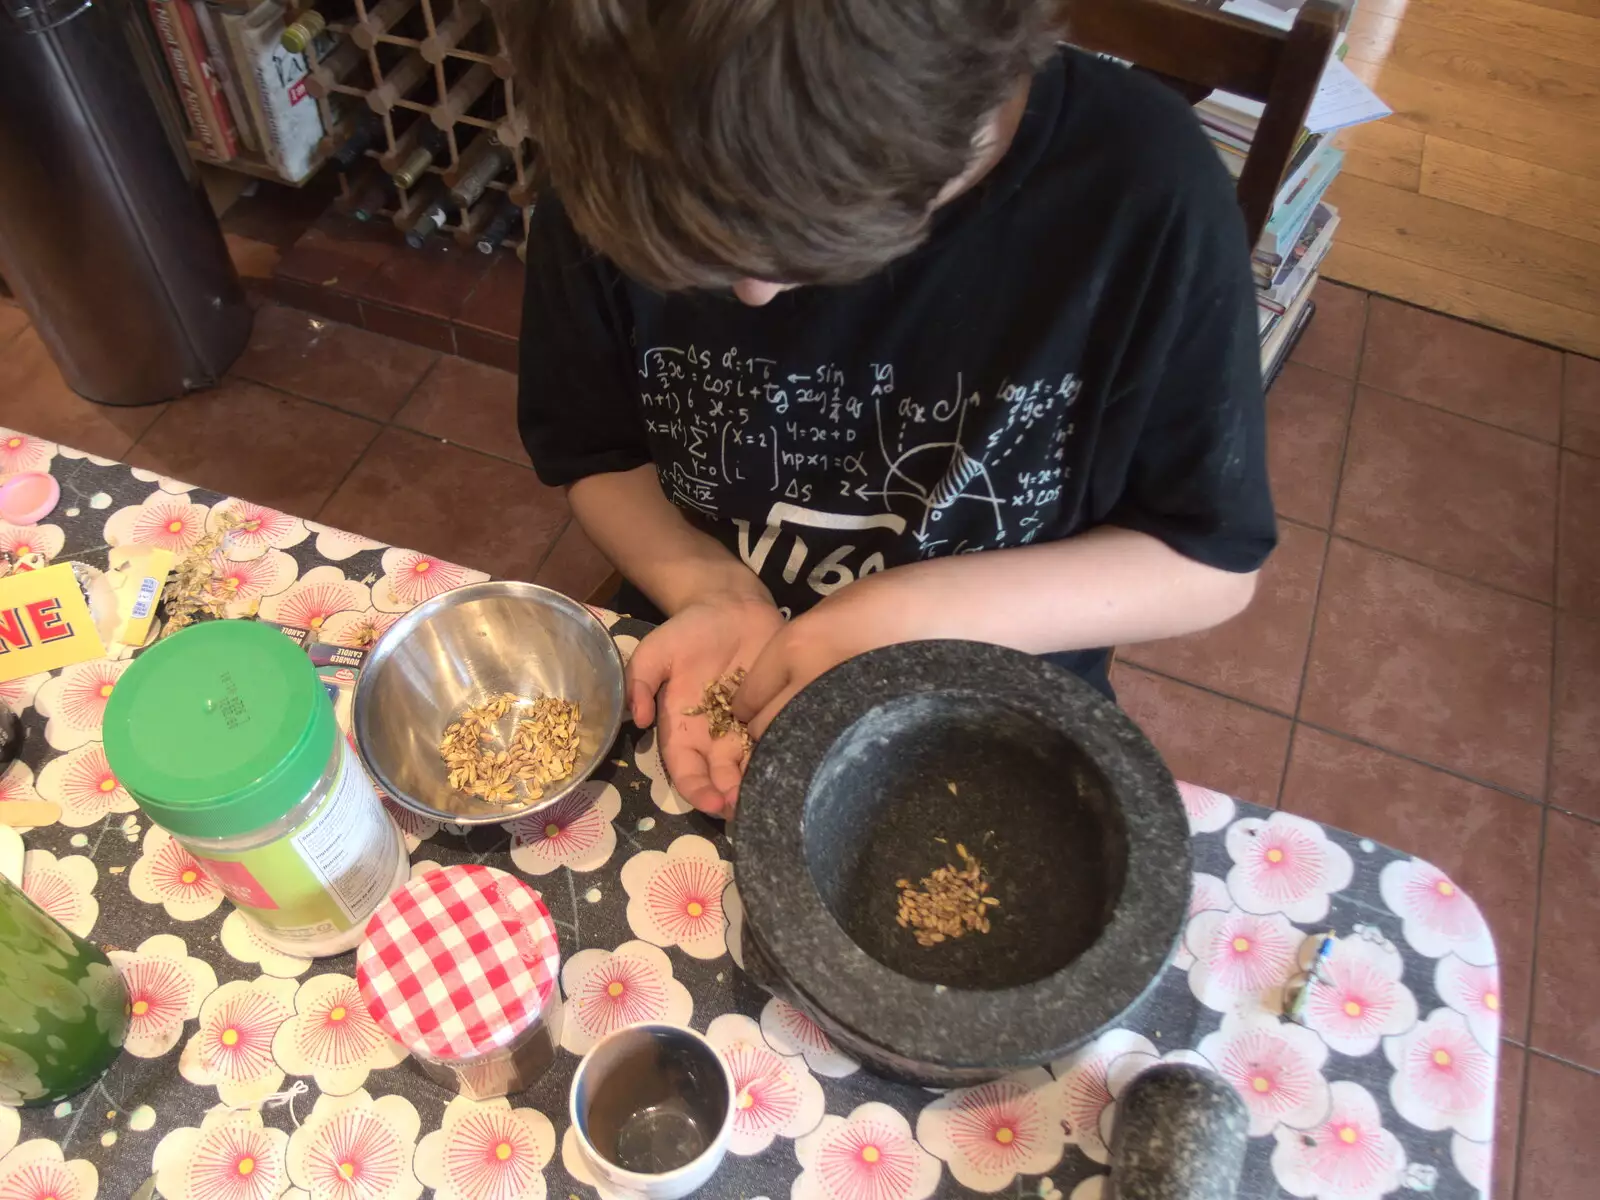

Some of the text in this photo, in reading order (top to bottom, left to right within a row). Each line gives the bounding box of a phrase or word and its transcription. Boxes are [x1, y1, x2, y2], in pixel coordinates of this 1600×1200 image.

[280, 627, 306, 638] CANDLE
[336, 648, 363, 658] CANDLE
[330, 655, 360, 666] NUMBER
